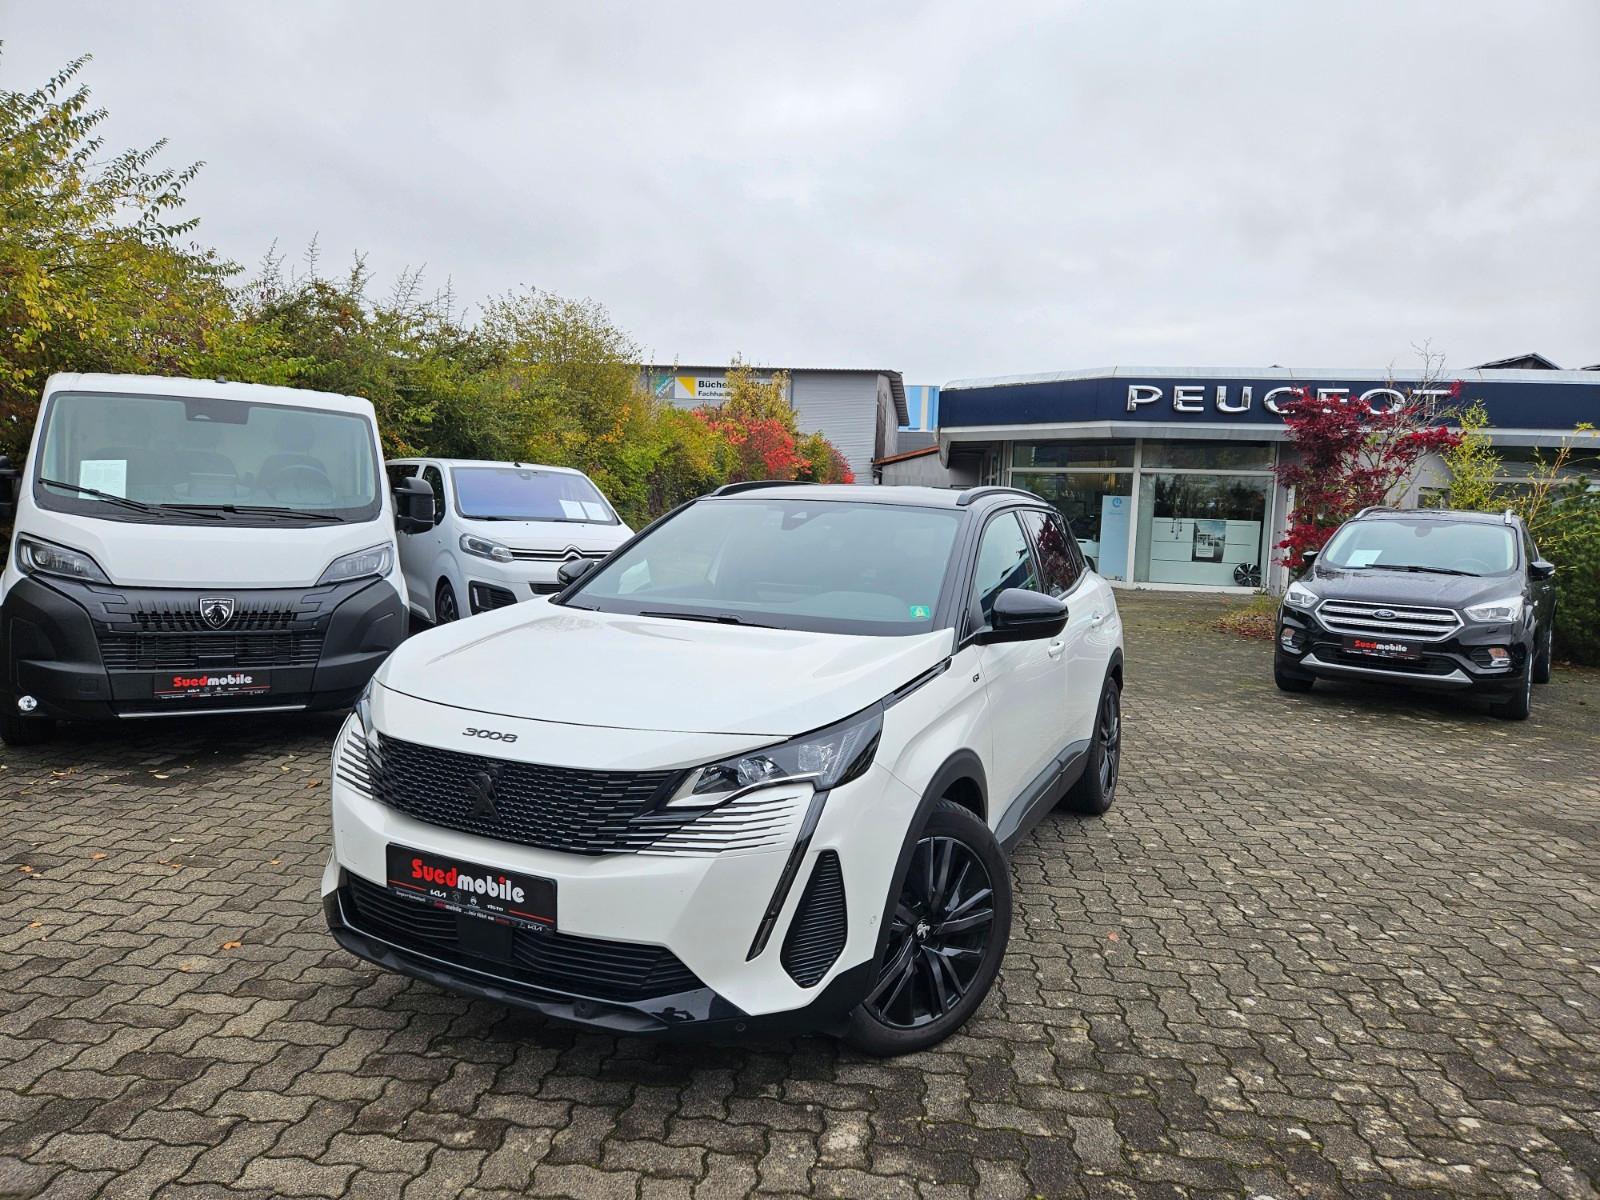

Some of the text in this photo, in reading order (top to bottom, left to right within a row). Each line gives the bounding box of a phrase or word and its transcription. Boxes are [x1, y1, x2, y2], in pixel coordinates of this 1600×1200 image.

[1354, 640, 1408, 652] Suedmobile
[173, 673, 253, 687] Suedmobile
[462, 727, 518, 743] 3008
[411, 858, 525, 904] Suedmobile
